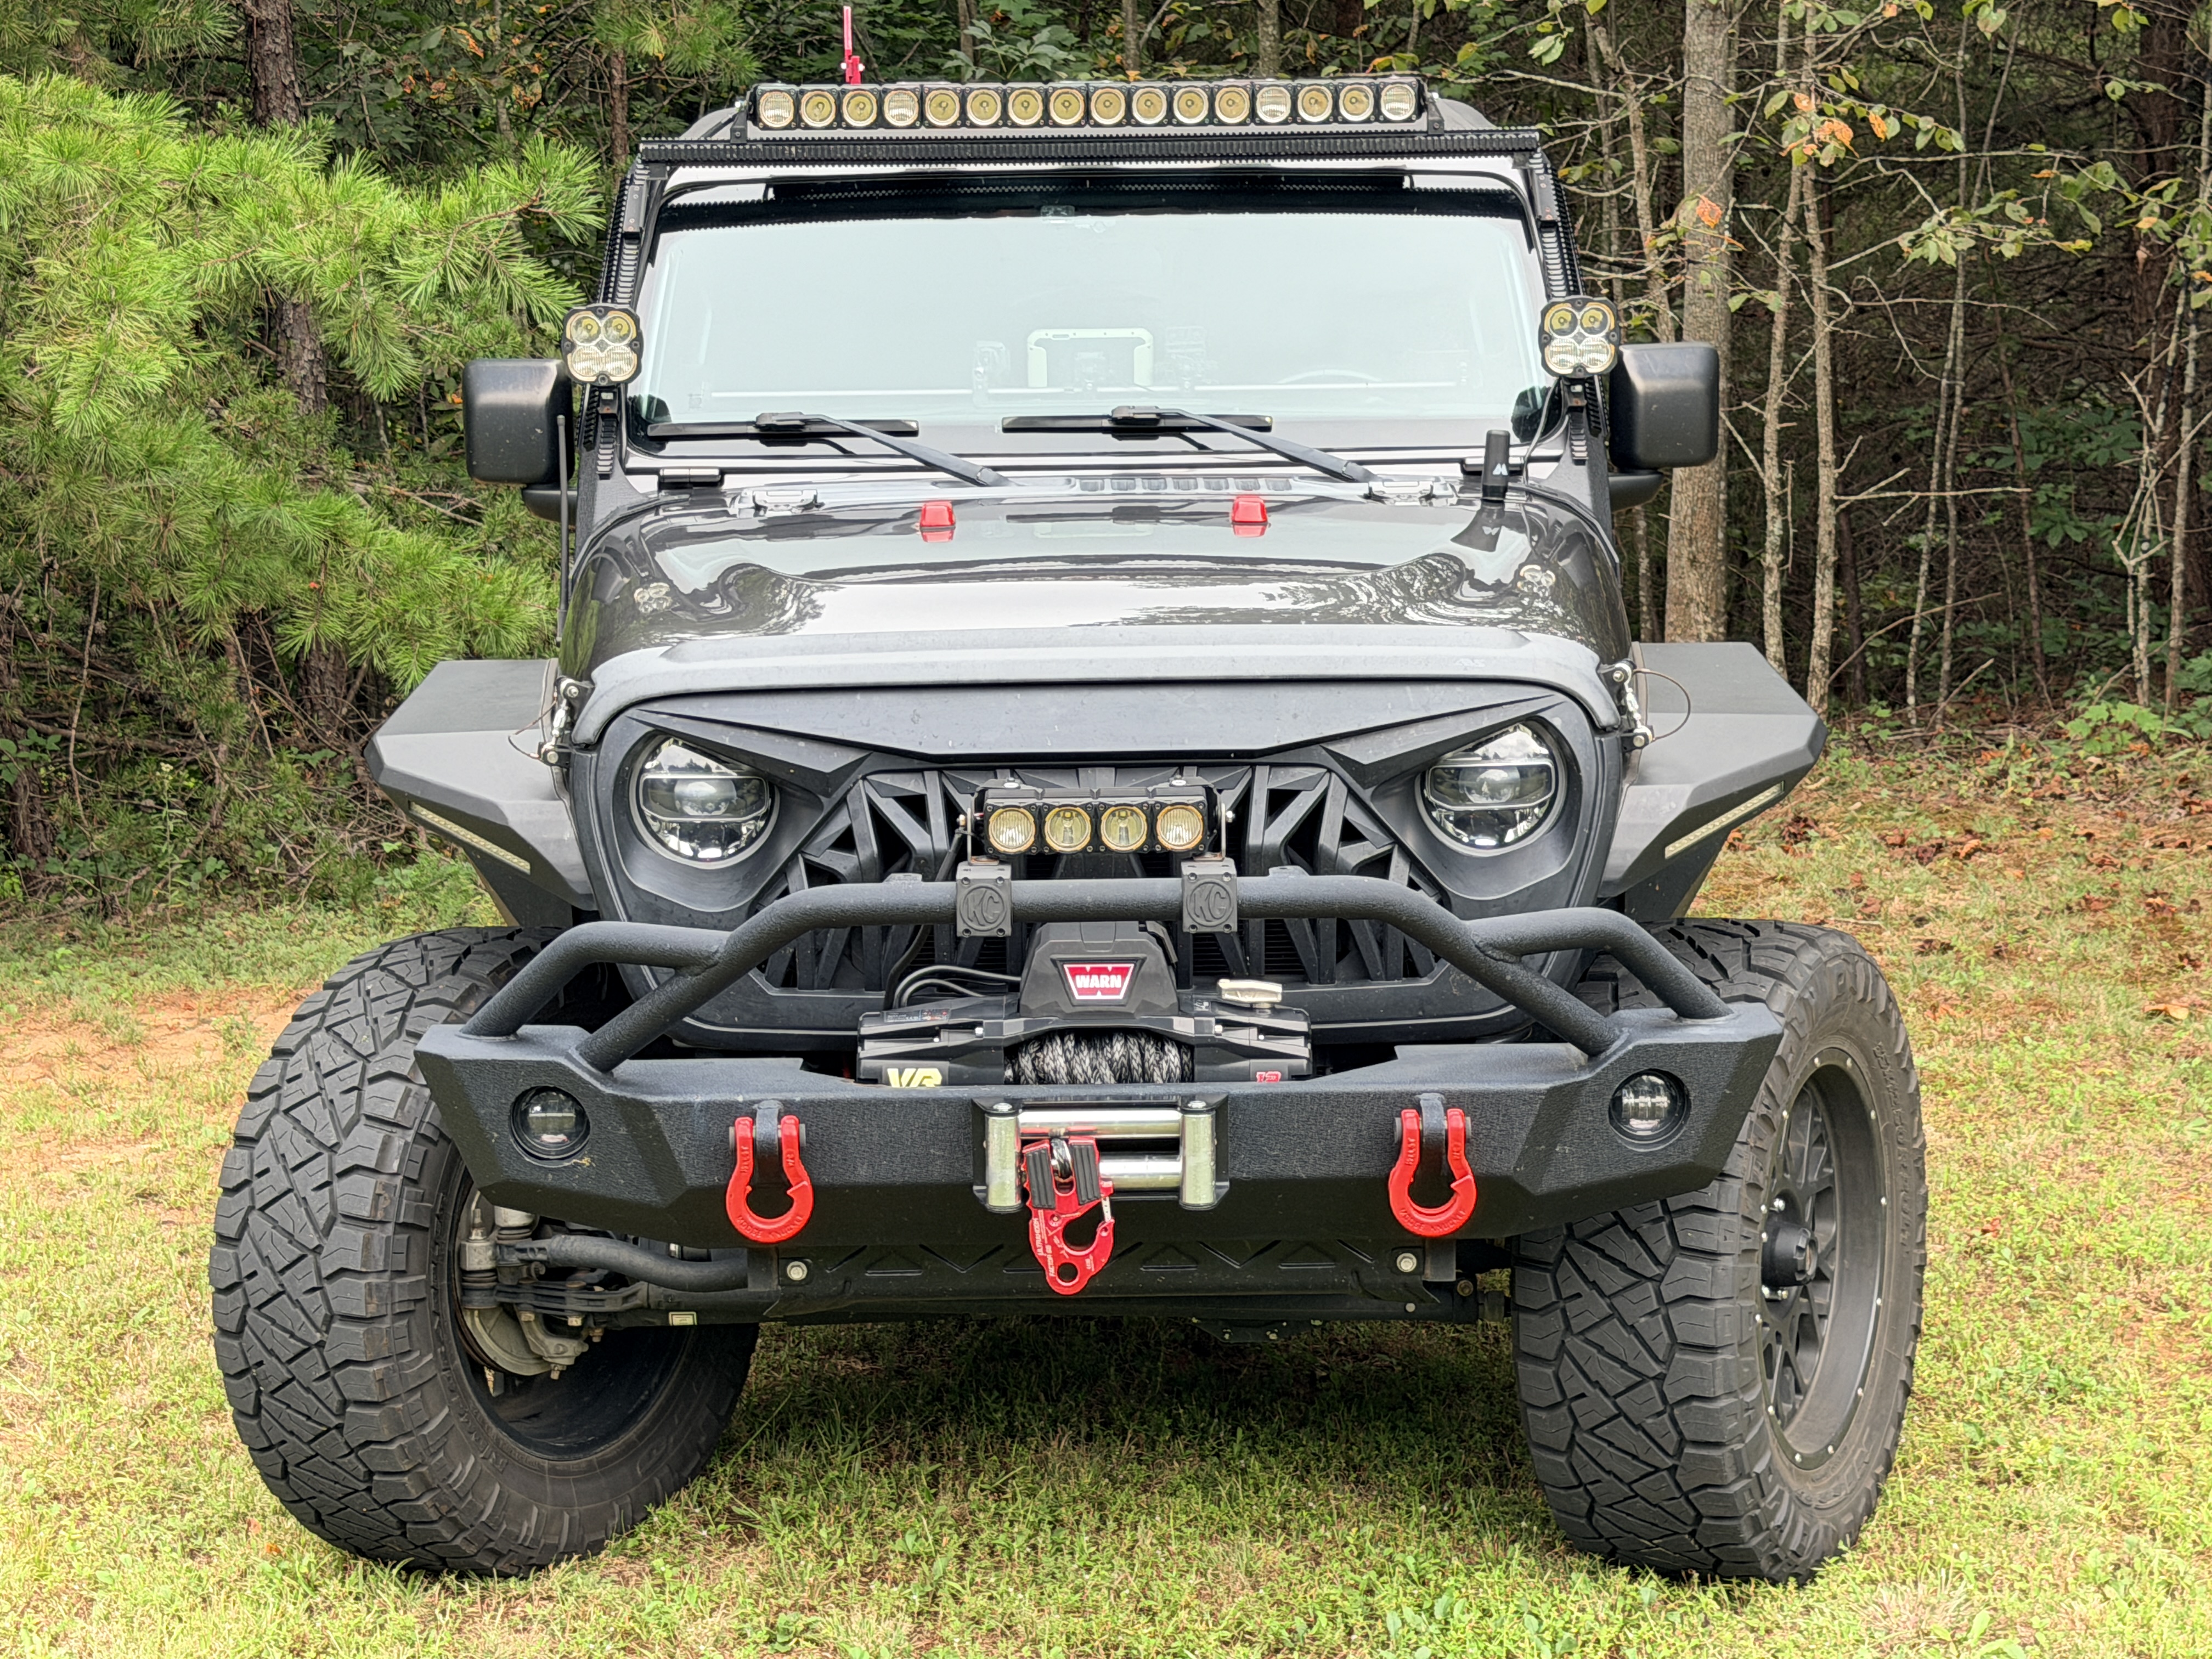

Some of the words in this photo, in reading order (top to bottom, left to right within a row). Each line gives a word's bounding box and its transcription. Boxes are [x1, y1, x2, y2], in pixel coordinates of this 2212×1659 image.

[963, 889, 1002, 926] KC
[1189, 884, 1228, 922] KC
[1075, 974, 1122, 988] WARN
[887, 1068, 943, 1088] VR
